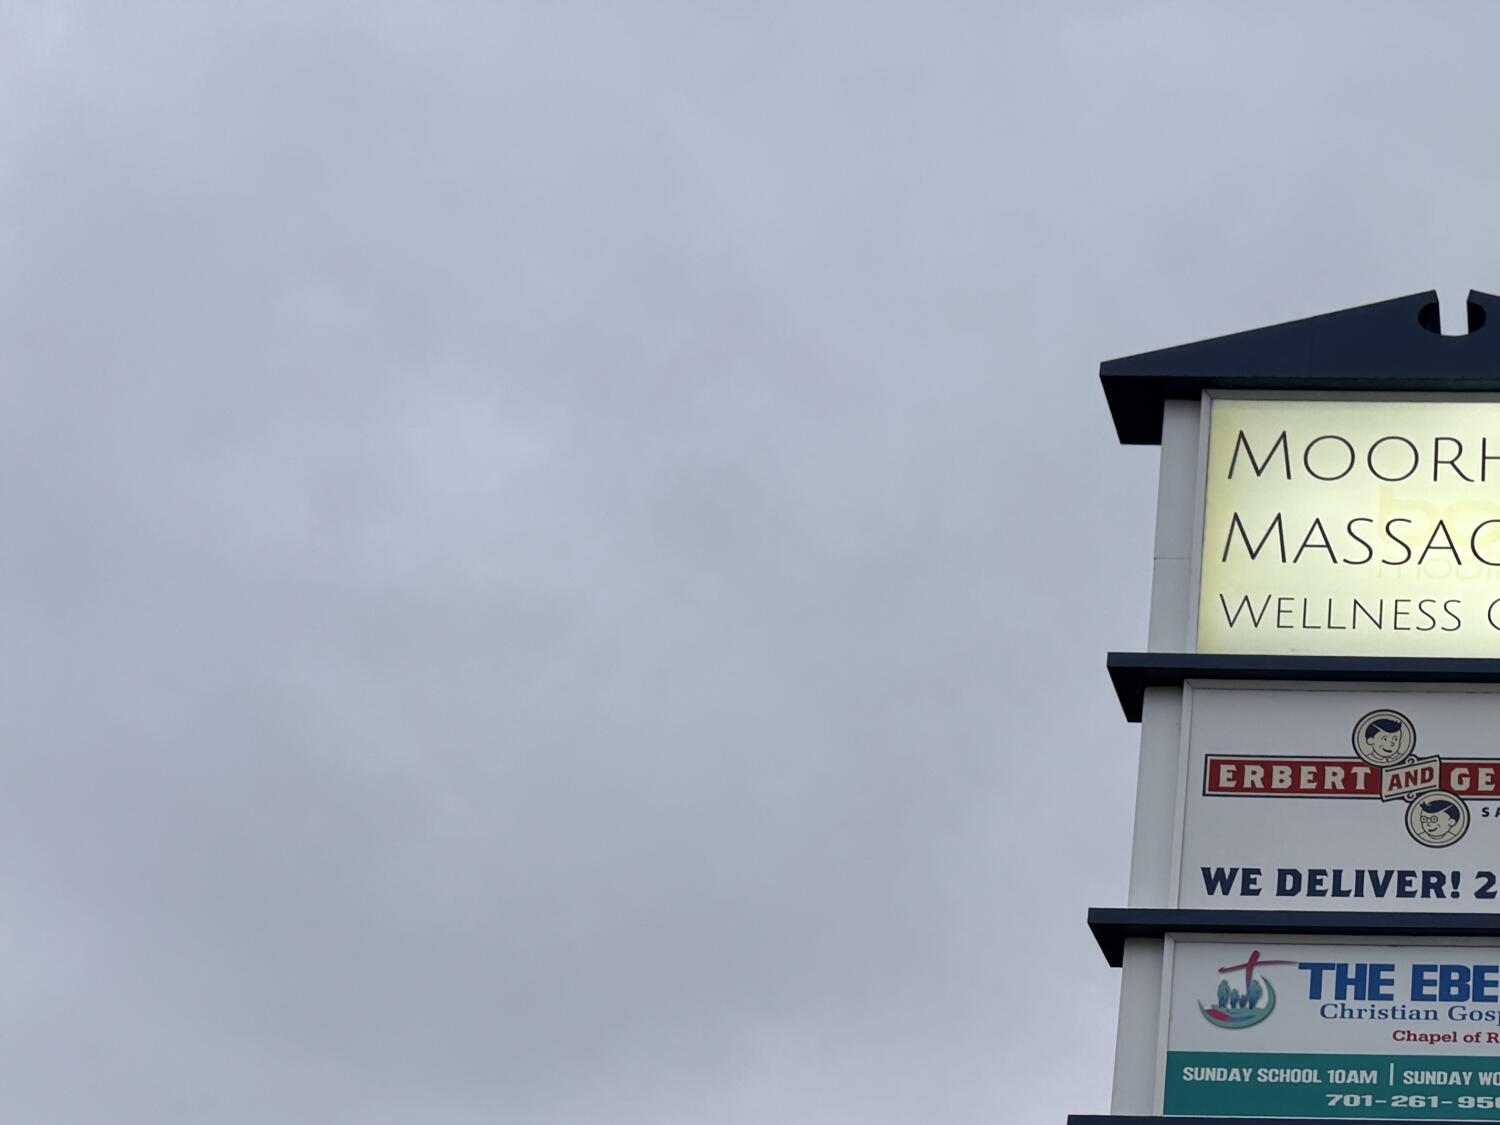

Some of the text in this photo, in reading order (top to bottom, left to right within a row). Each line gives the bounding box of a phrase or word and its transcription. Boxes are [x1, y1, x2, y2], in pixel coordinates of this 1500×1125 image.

[1219, 593, 1462, 631] WELLNESS
[1218, 763, 1371, 791] ERBERT
[1388, 767, 1435, 792] AND
[1200, 866, 1262, 897] WE
[1276, 868, 1461, 899] DELIVER!
[1298, 962, 1395, 1001] THE
[1320, 1003, 1439, 1022] Christian
[1392, 1030, 1458, 1045] Chapel
[1462, 1031, 1482, 1044] of
[1182, 1066, 1378, 1085] SUNDAY SCHOOL 10AM
[1403, 1070, 1473, 1086] SUNDAY
